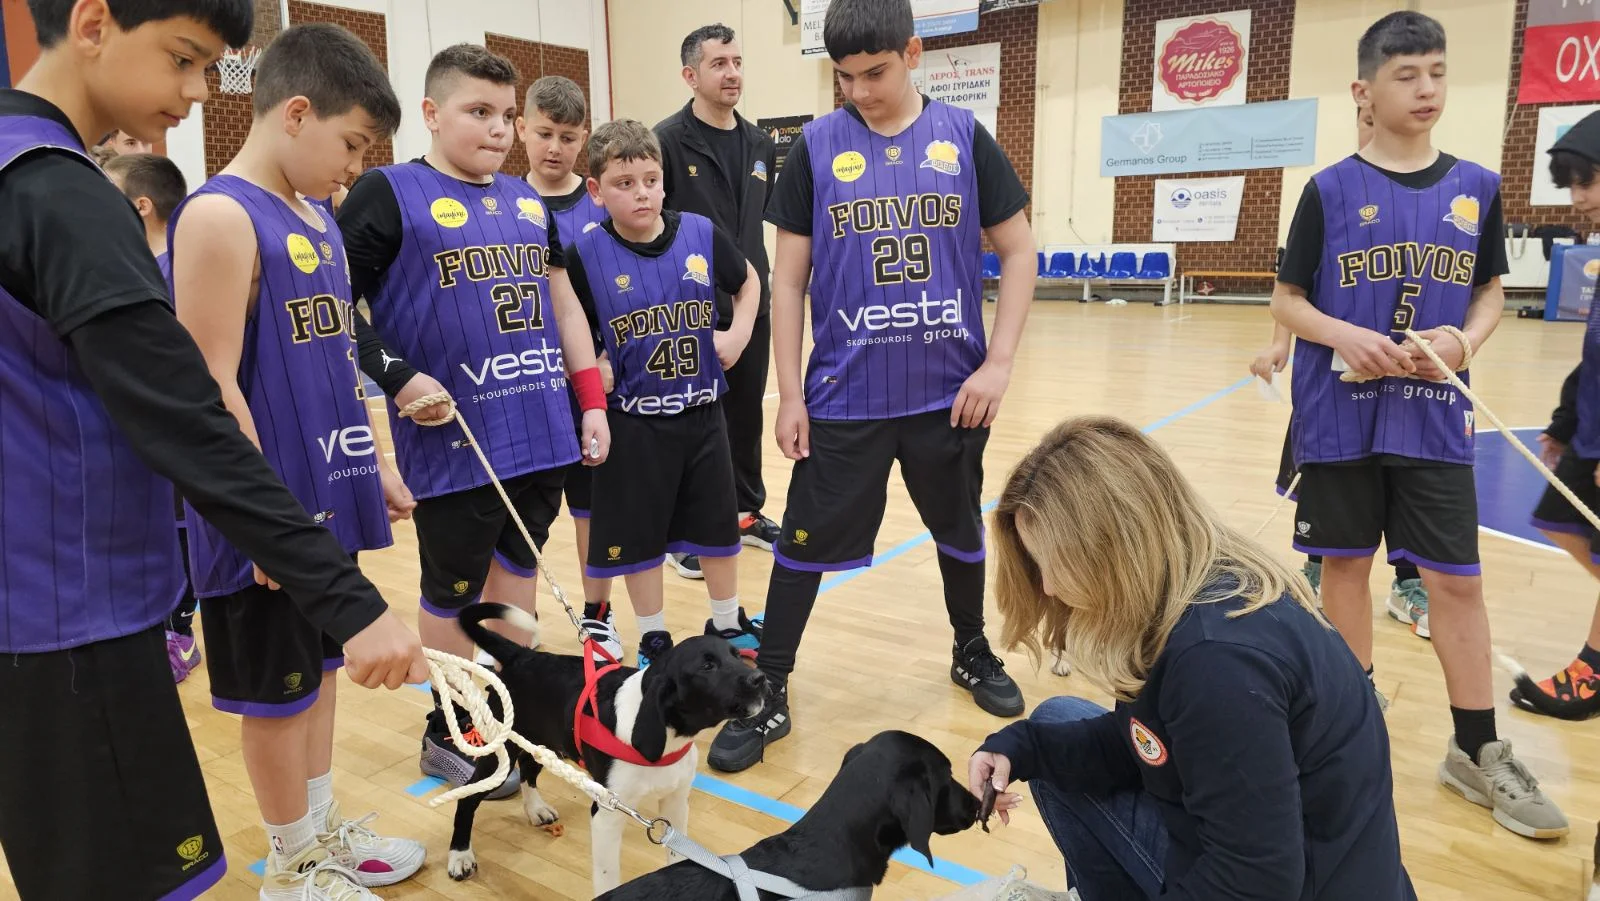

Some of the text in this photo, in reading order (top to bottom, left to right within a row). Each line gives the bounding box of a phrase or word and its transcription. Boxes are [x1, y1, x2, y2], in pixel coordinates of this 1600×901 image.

[1168, 50, 1235, 74] Mikes
[1106, 156, 1154, 167] Germanos
[1157, 154, 1187, 165] Group
[828, 193, 962, 239] FOIVOS
[1194, 188, 1227, 200] oasis
[871, 233, 932, 285] 29
[1337, 242, 1476, 288] FOIVOS
[490, 282, 545, 334] 27
[609, 300, 713, 348] FOIVOS
[837, 288, 963, 332] vestal
[1391, 283, 1422, 333] 5
[645, 335, 700, 380] 49
[846, 327, 969, 347] SKOUBOURDIS group
[472, 382, 546, 403] SKOUBOURDIS
[617, 378, 719, 415] vestal
[1403, 384, 1457, 406] group
